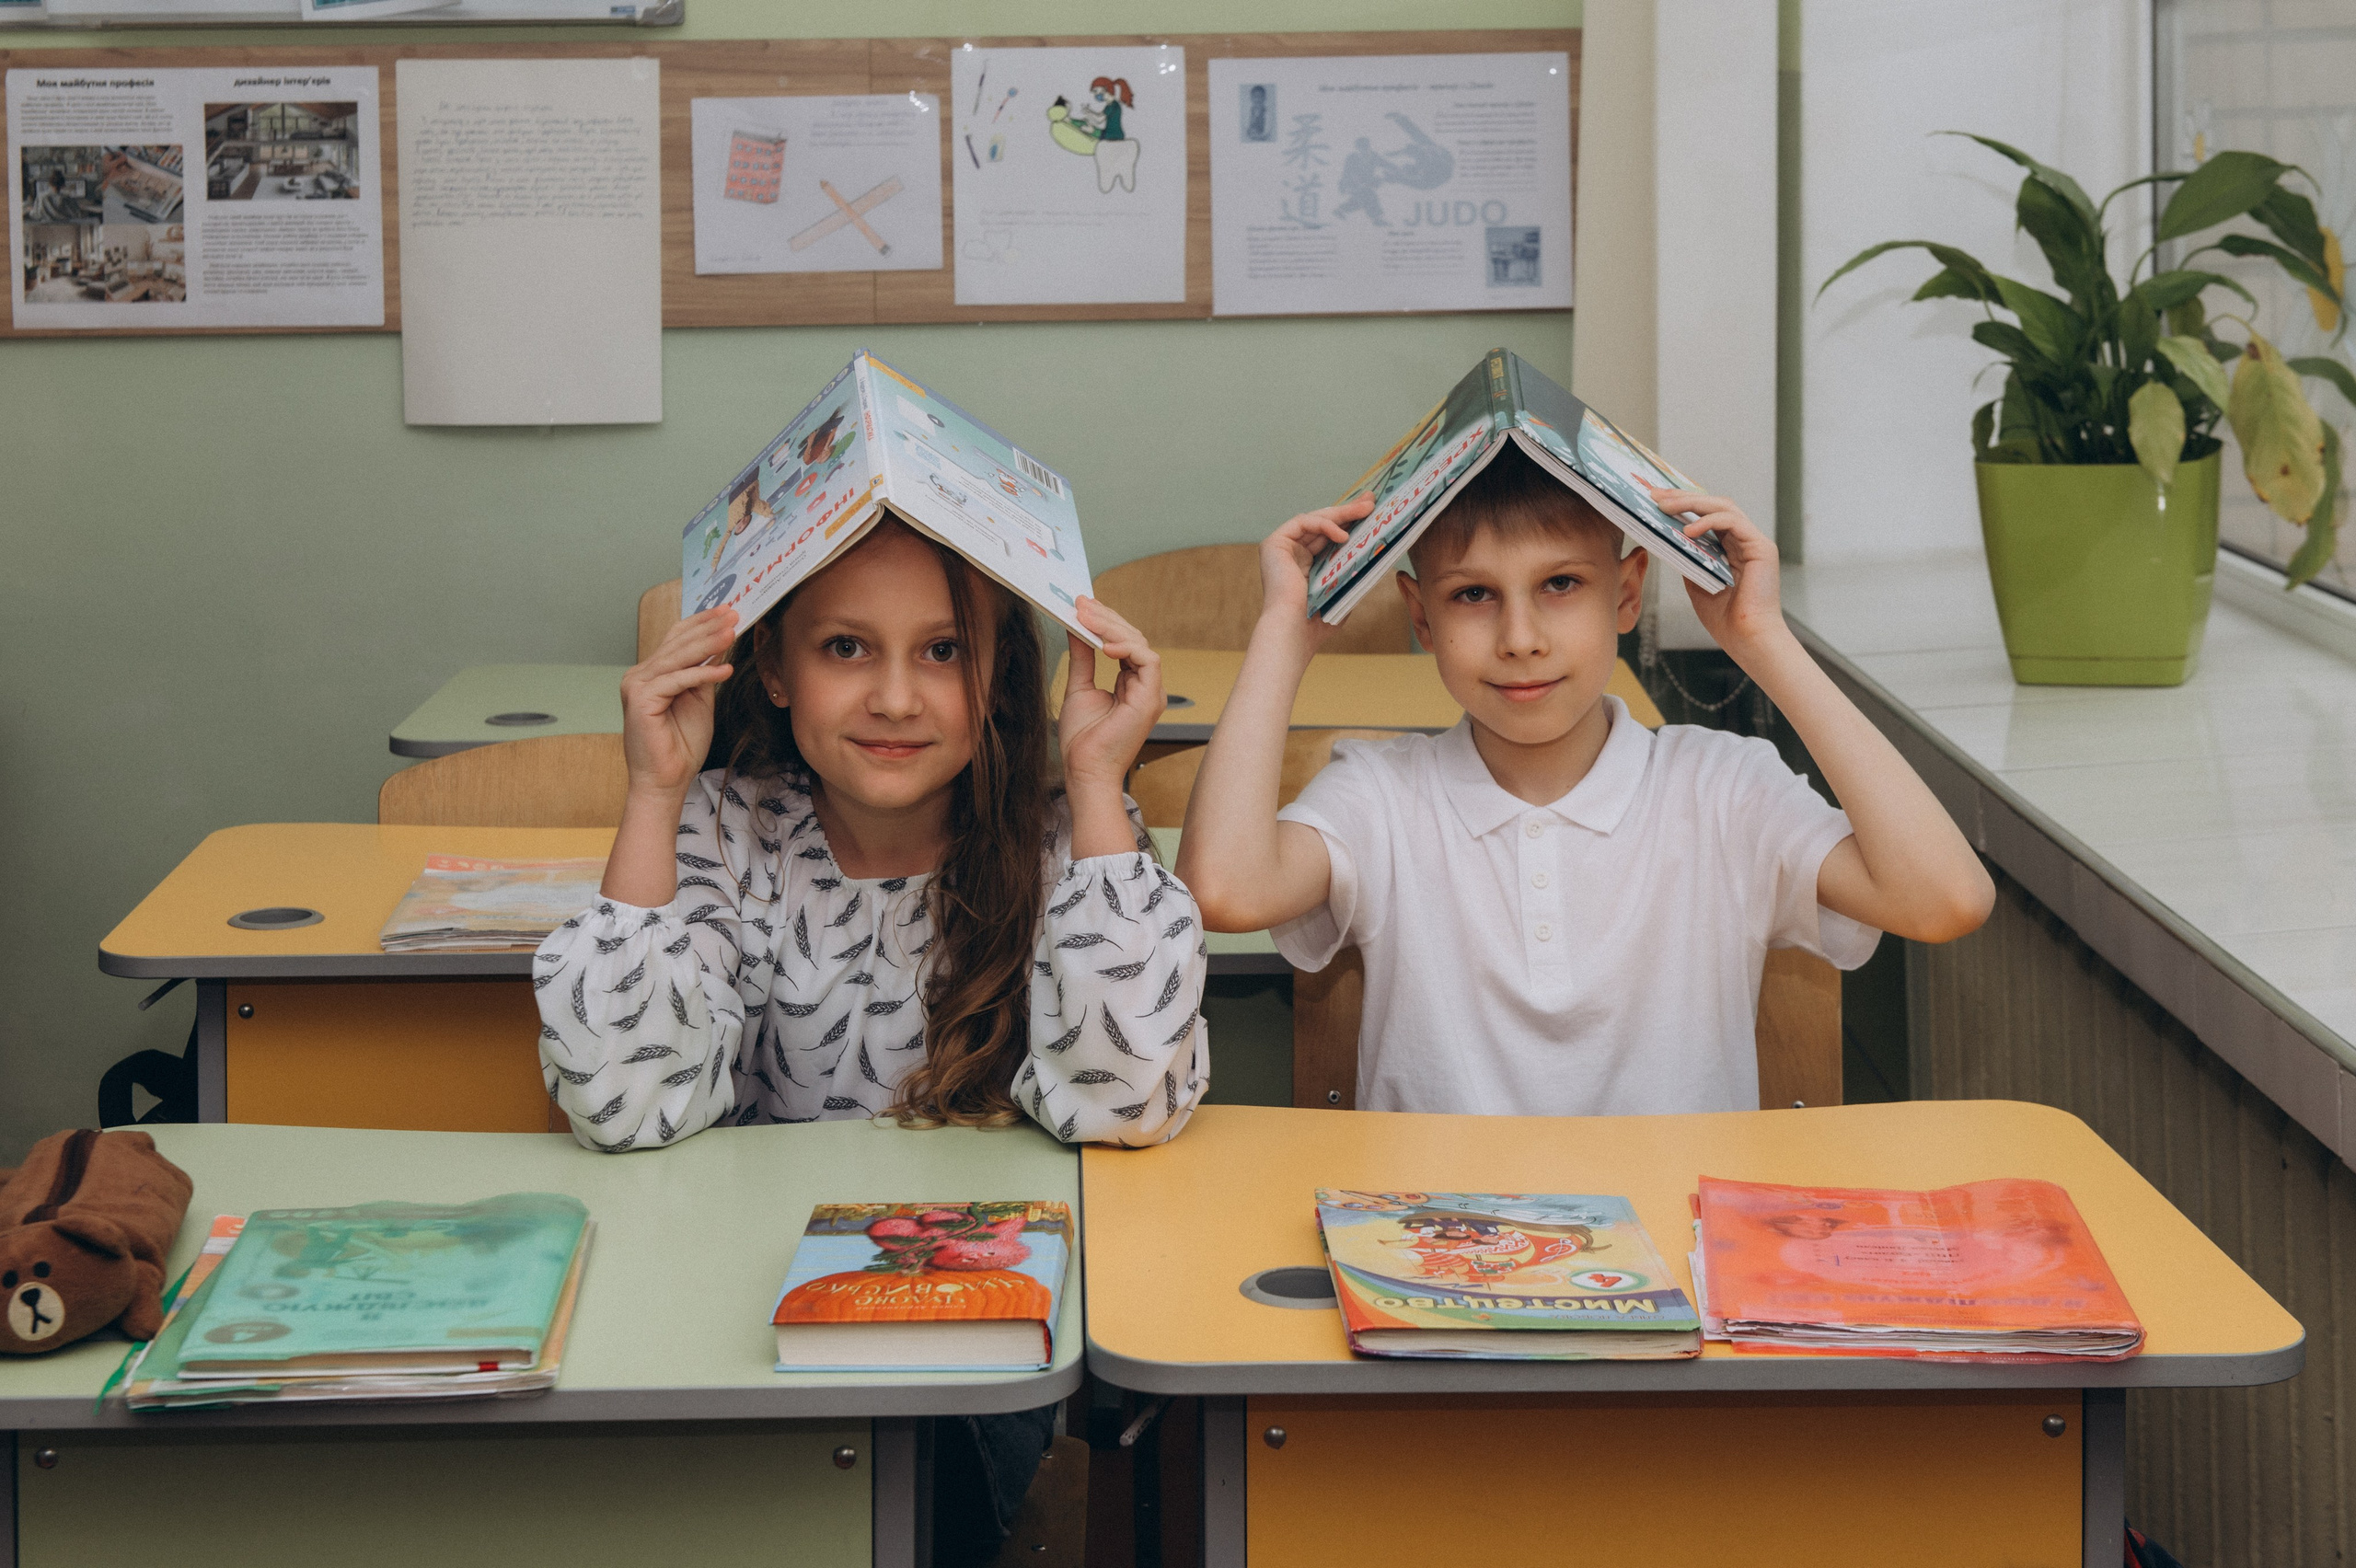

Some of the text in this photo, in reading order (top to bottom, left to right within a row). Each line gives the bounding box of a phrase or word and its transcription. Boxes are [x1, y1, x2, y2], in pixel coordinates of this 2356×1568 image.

[36, 77, 155, 89] Моя майбутня професія
[1403, 199, 1507, 227] JUDO
[1321, 424, 1484, 586] ХРЕСТОМАТІЯ
[727, 487, 855, 608] ІНФОРМАТИ
[702, 582, 726, 604] КЛАС
[1588, 1273, 1623, 1288] 4
[854, 1294, 965, 1306] ЧУДОВЕ
[1375, 1294, 1658, 1314] Мистецтво
